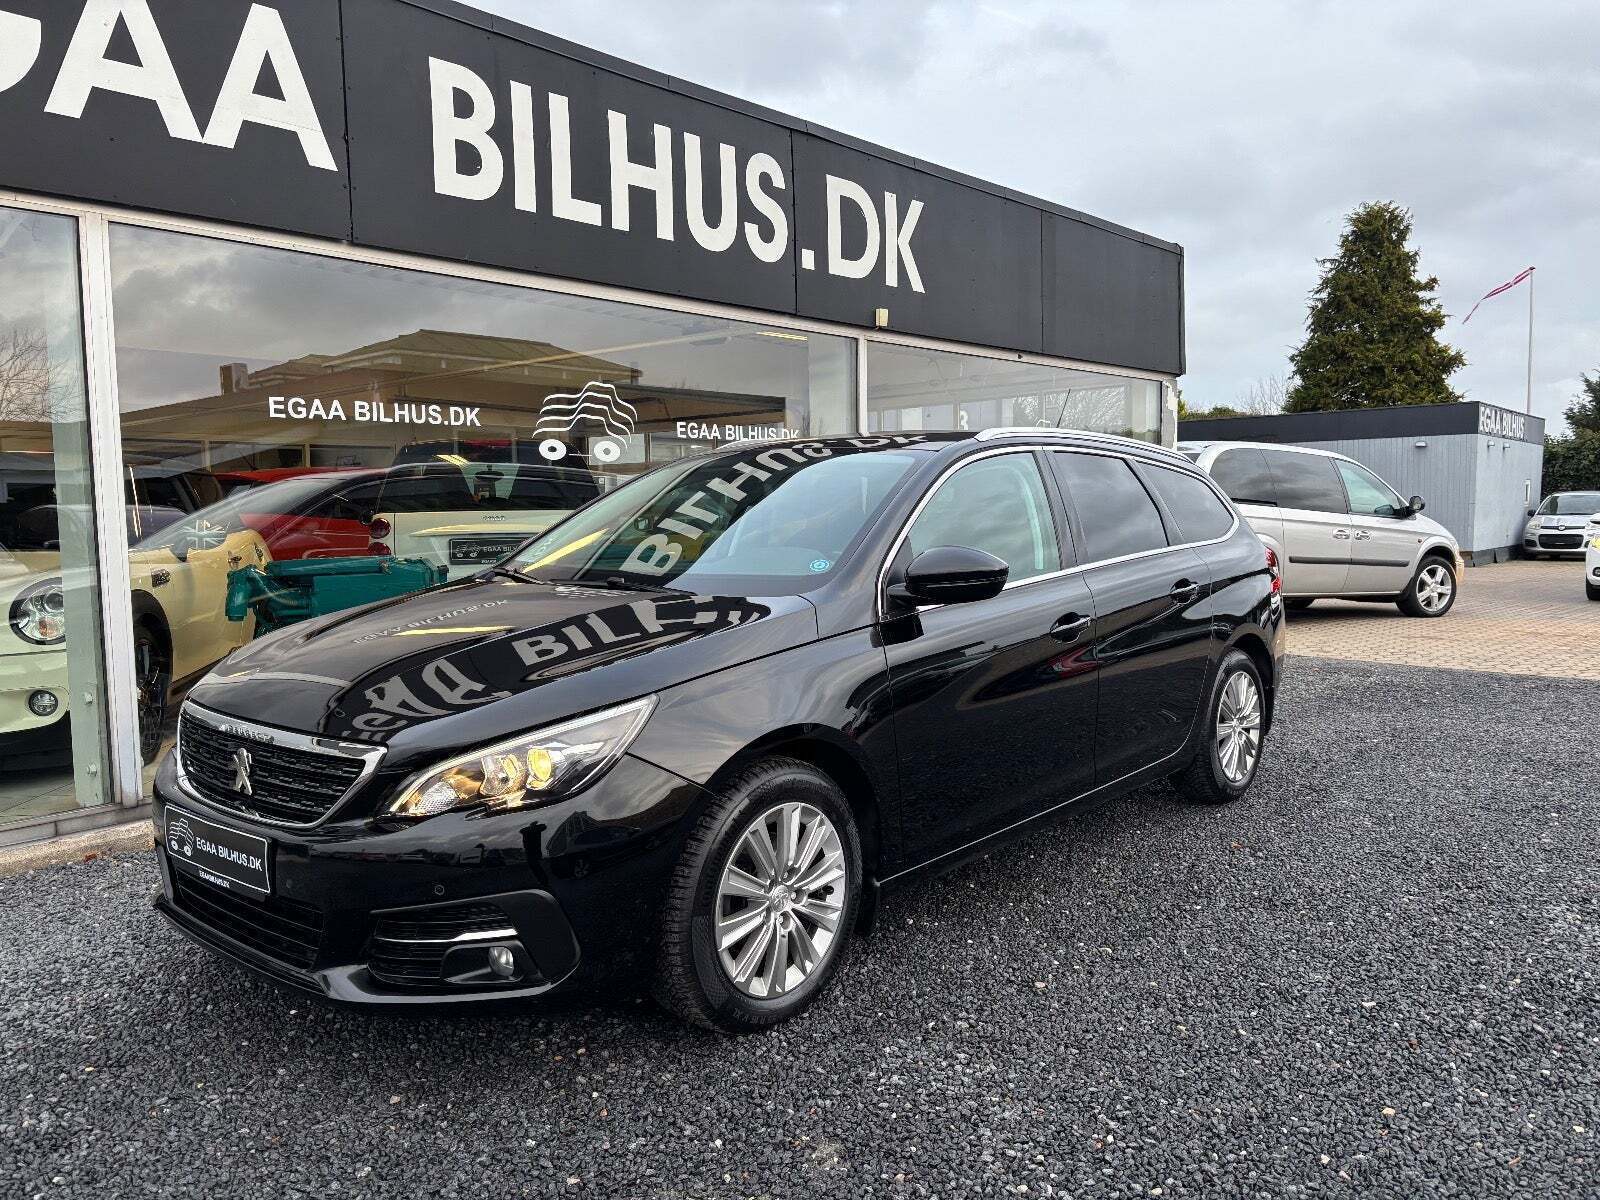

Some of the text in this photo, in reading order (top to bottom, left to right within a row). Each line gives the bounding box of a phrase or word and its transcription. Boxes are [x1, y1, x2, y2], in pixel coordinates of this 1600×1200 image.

[428, 56, 927, 295] BILHUS.DK
[268, 396, 481, 427] EGAA BILHUS.DK
[1480, 406, 1526, 439] EGAA BILHUS
[676, 421, 800, 441] EGAA BILHUSDK
[195, 836, 263, 871] EGAA BILHUS.DK
